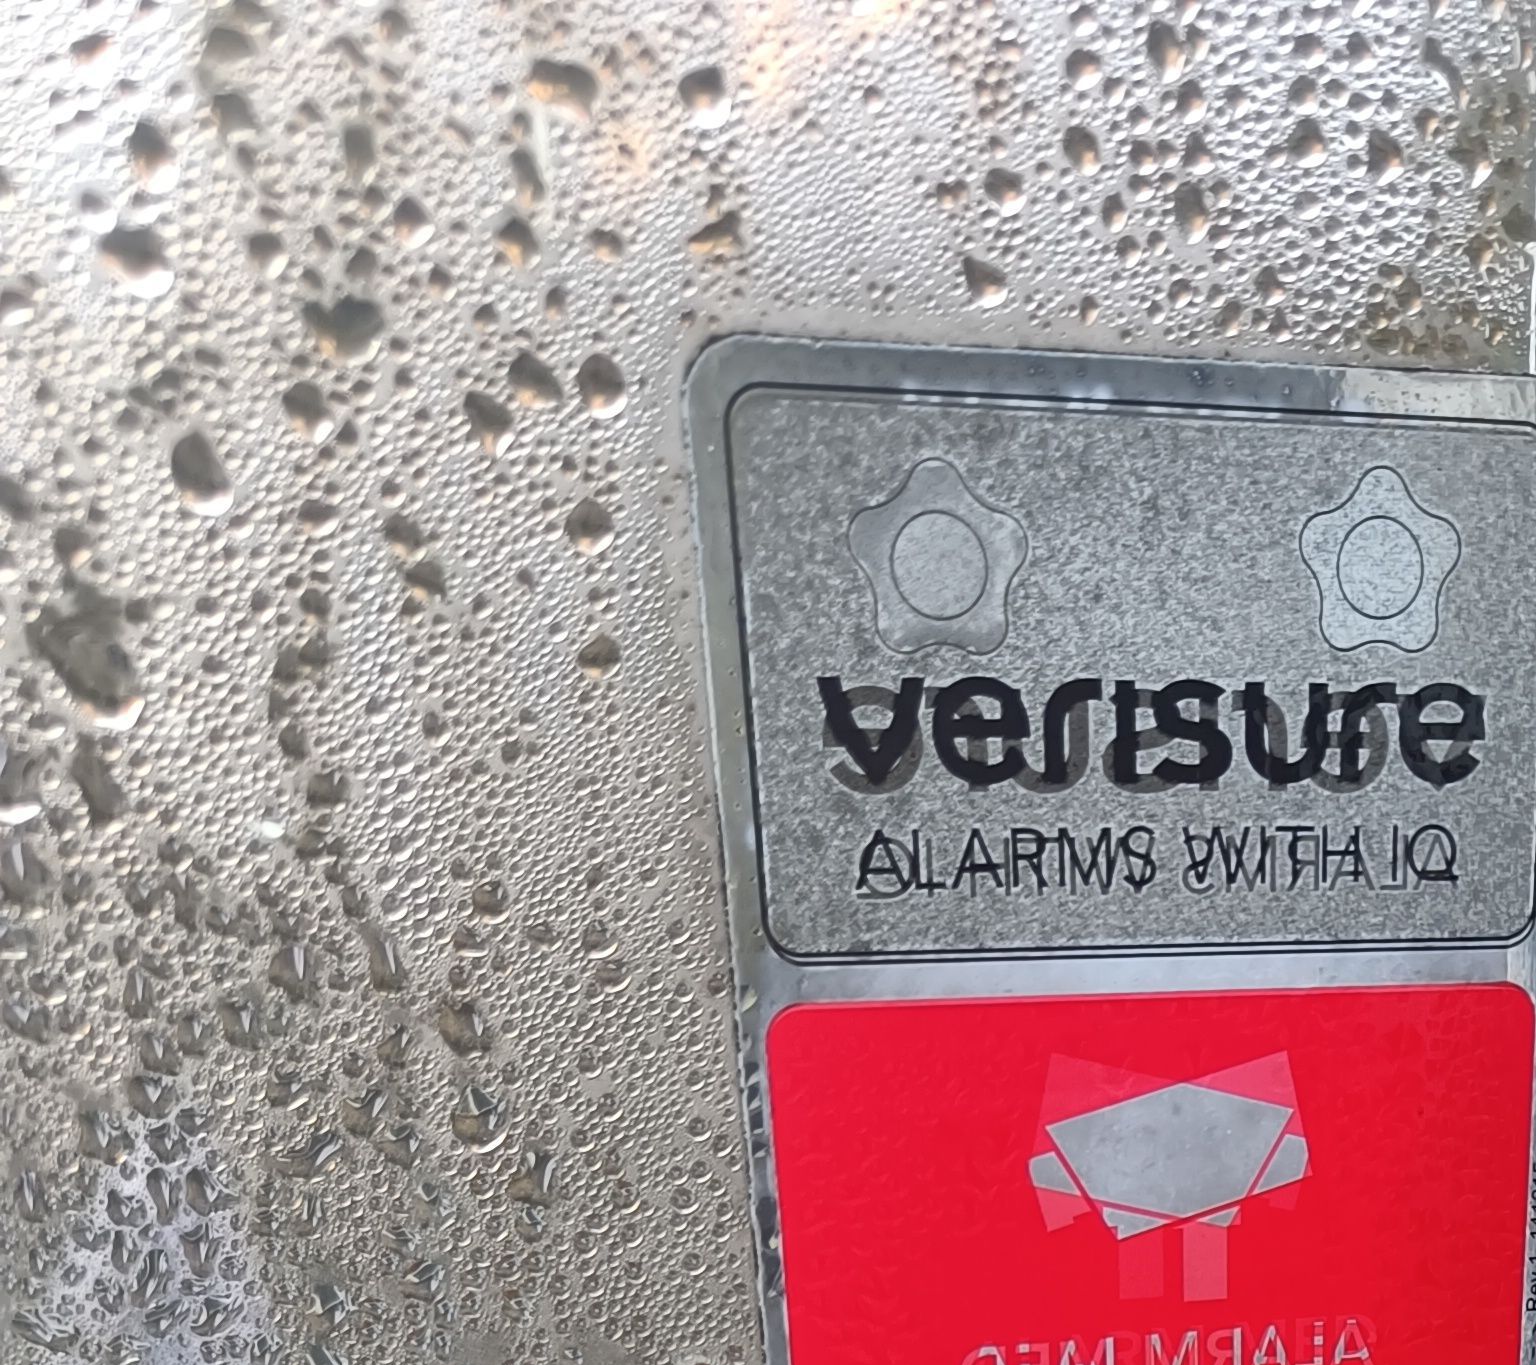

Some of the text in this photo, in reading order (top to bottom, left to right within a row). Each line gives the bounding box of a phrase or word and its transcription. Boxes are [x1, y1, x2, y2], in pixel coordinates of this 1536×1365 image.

[816, 675, 1486, 785] verisure
[856, 824, 1459, 891] ALARMS WITH IQ
